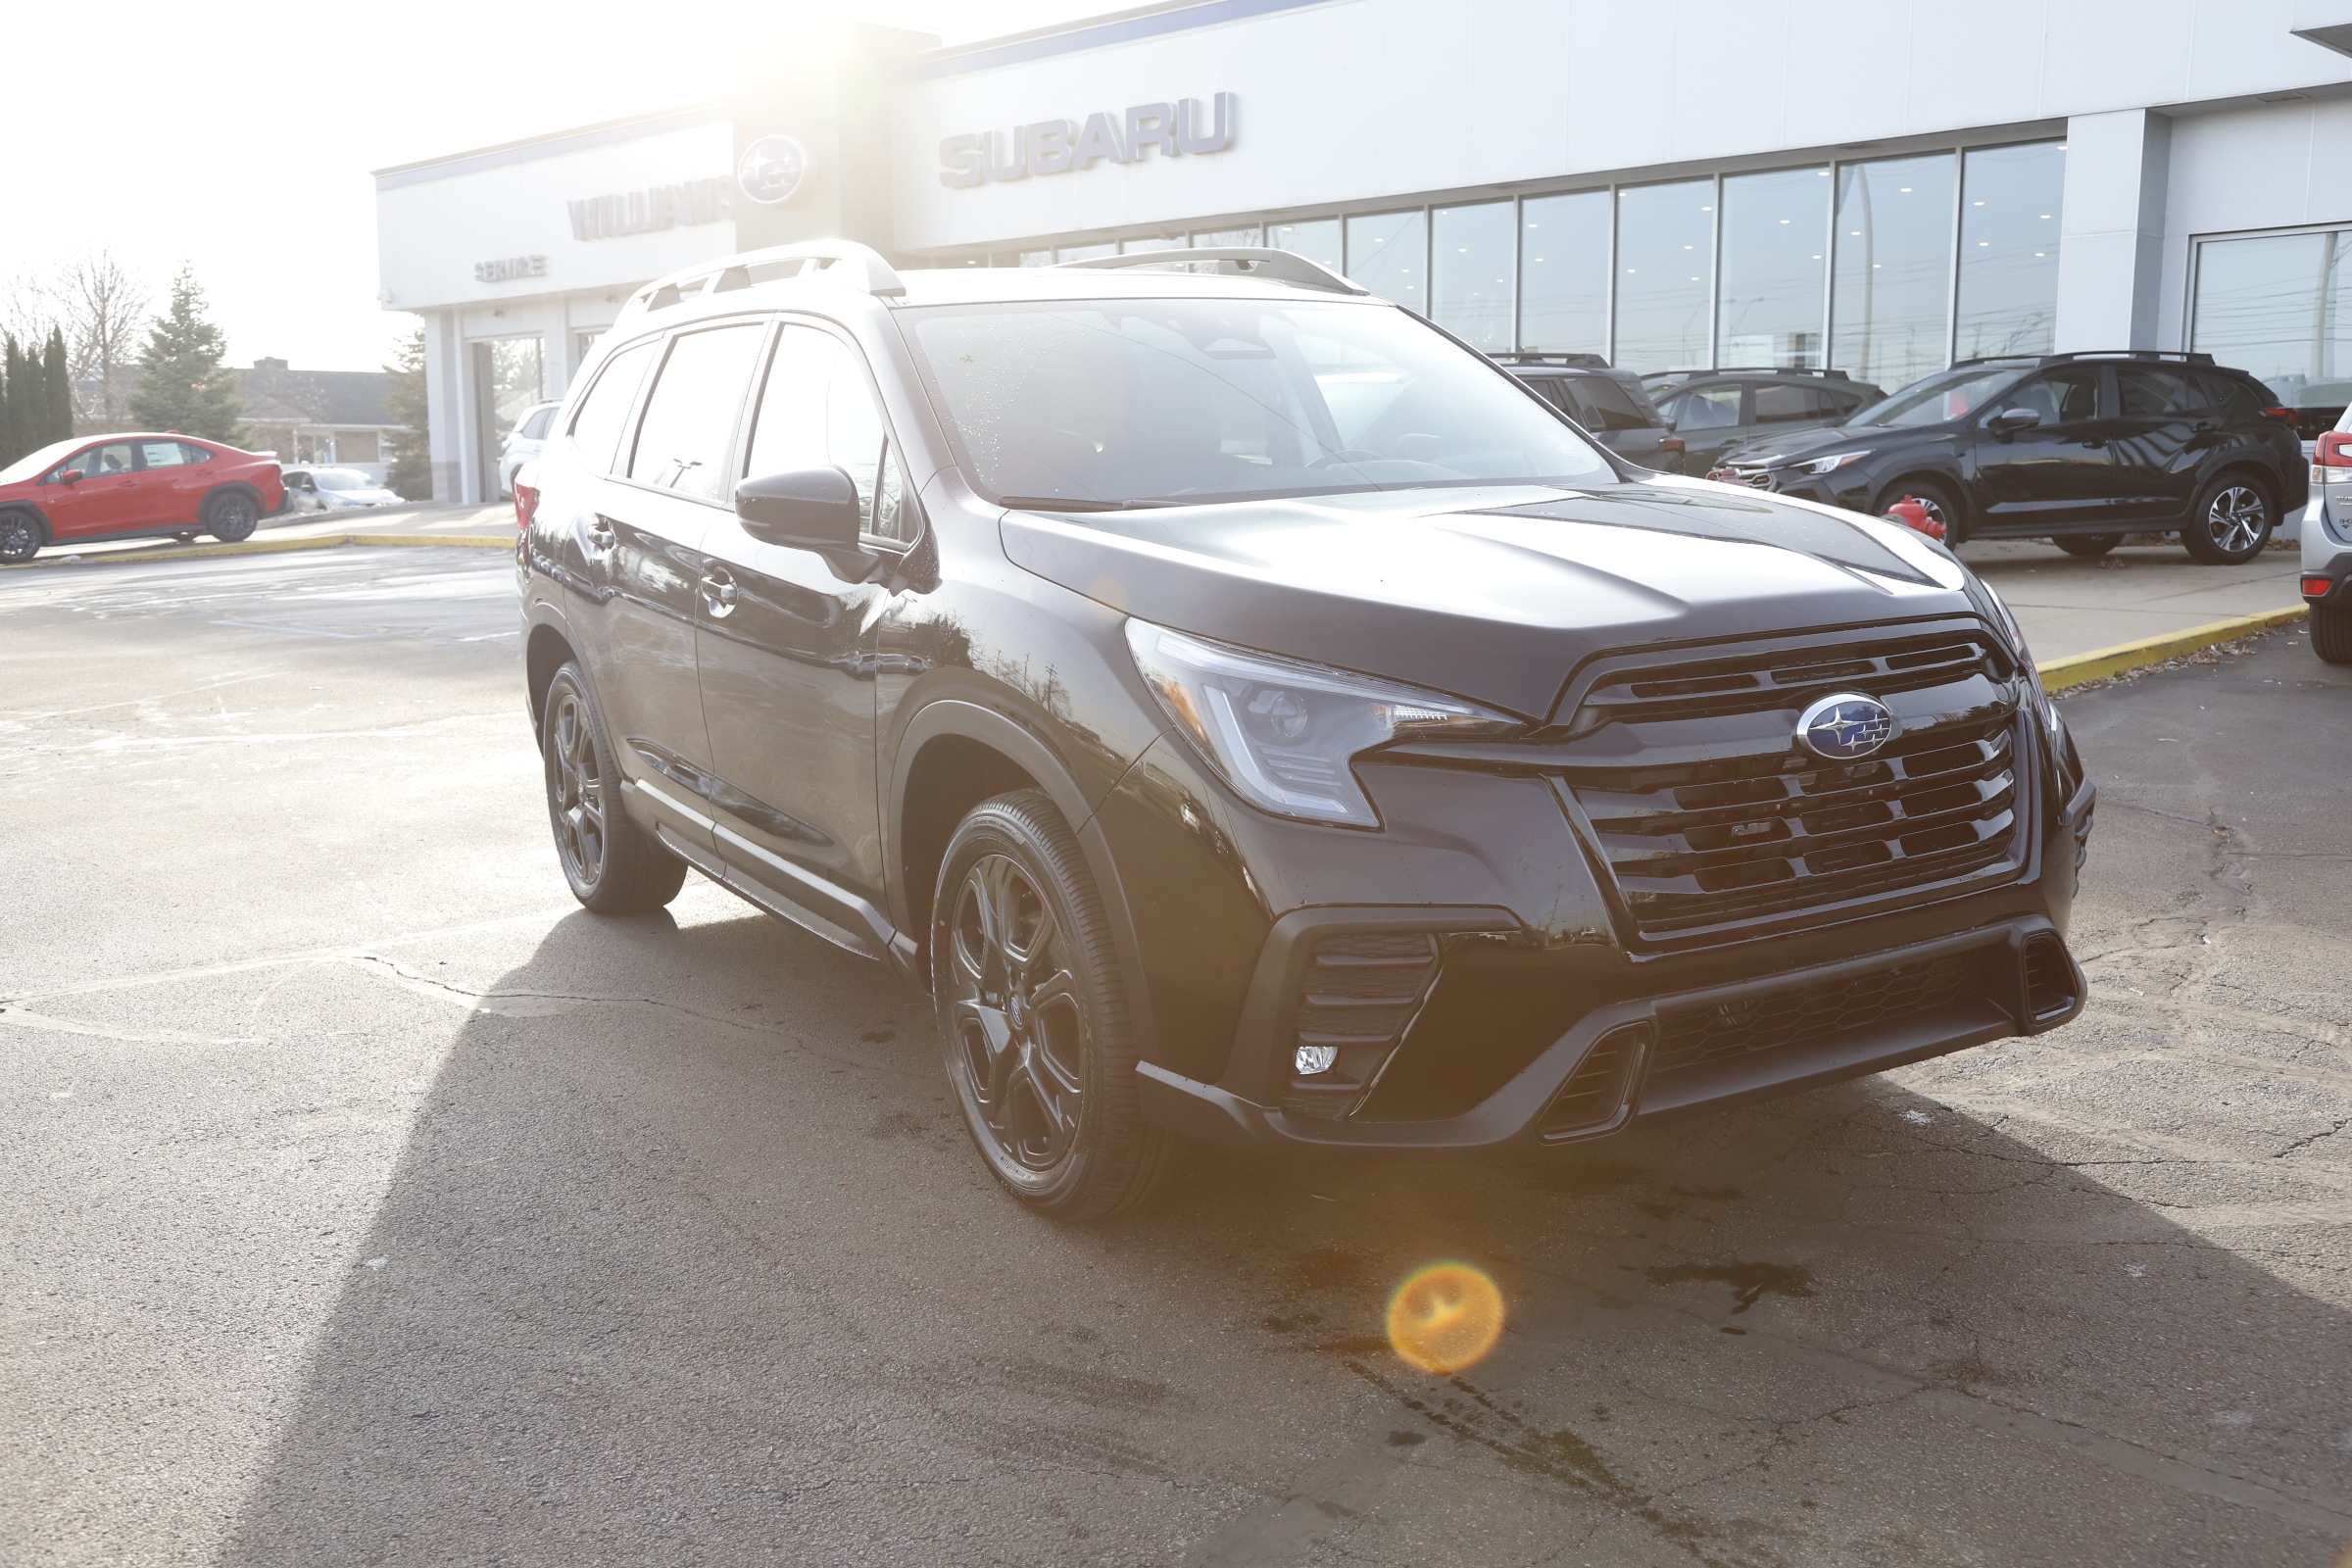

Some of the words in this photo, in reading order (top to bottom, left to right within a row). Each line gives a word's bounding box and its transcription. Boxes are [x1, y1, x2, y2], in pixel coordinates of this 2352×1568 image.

[939, 92, 1234, 188] SUBARU
[566, 174, 736, 242] WILLIAMS
[474, 255, 548, 282] SERVICE
